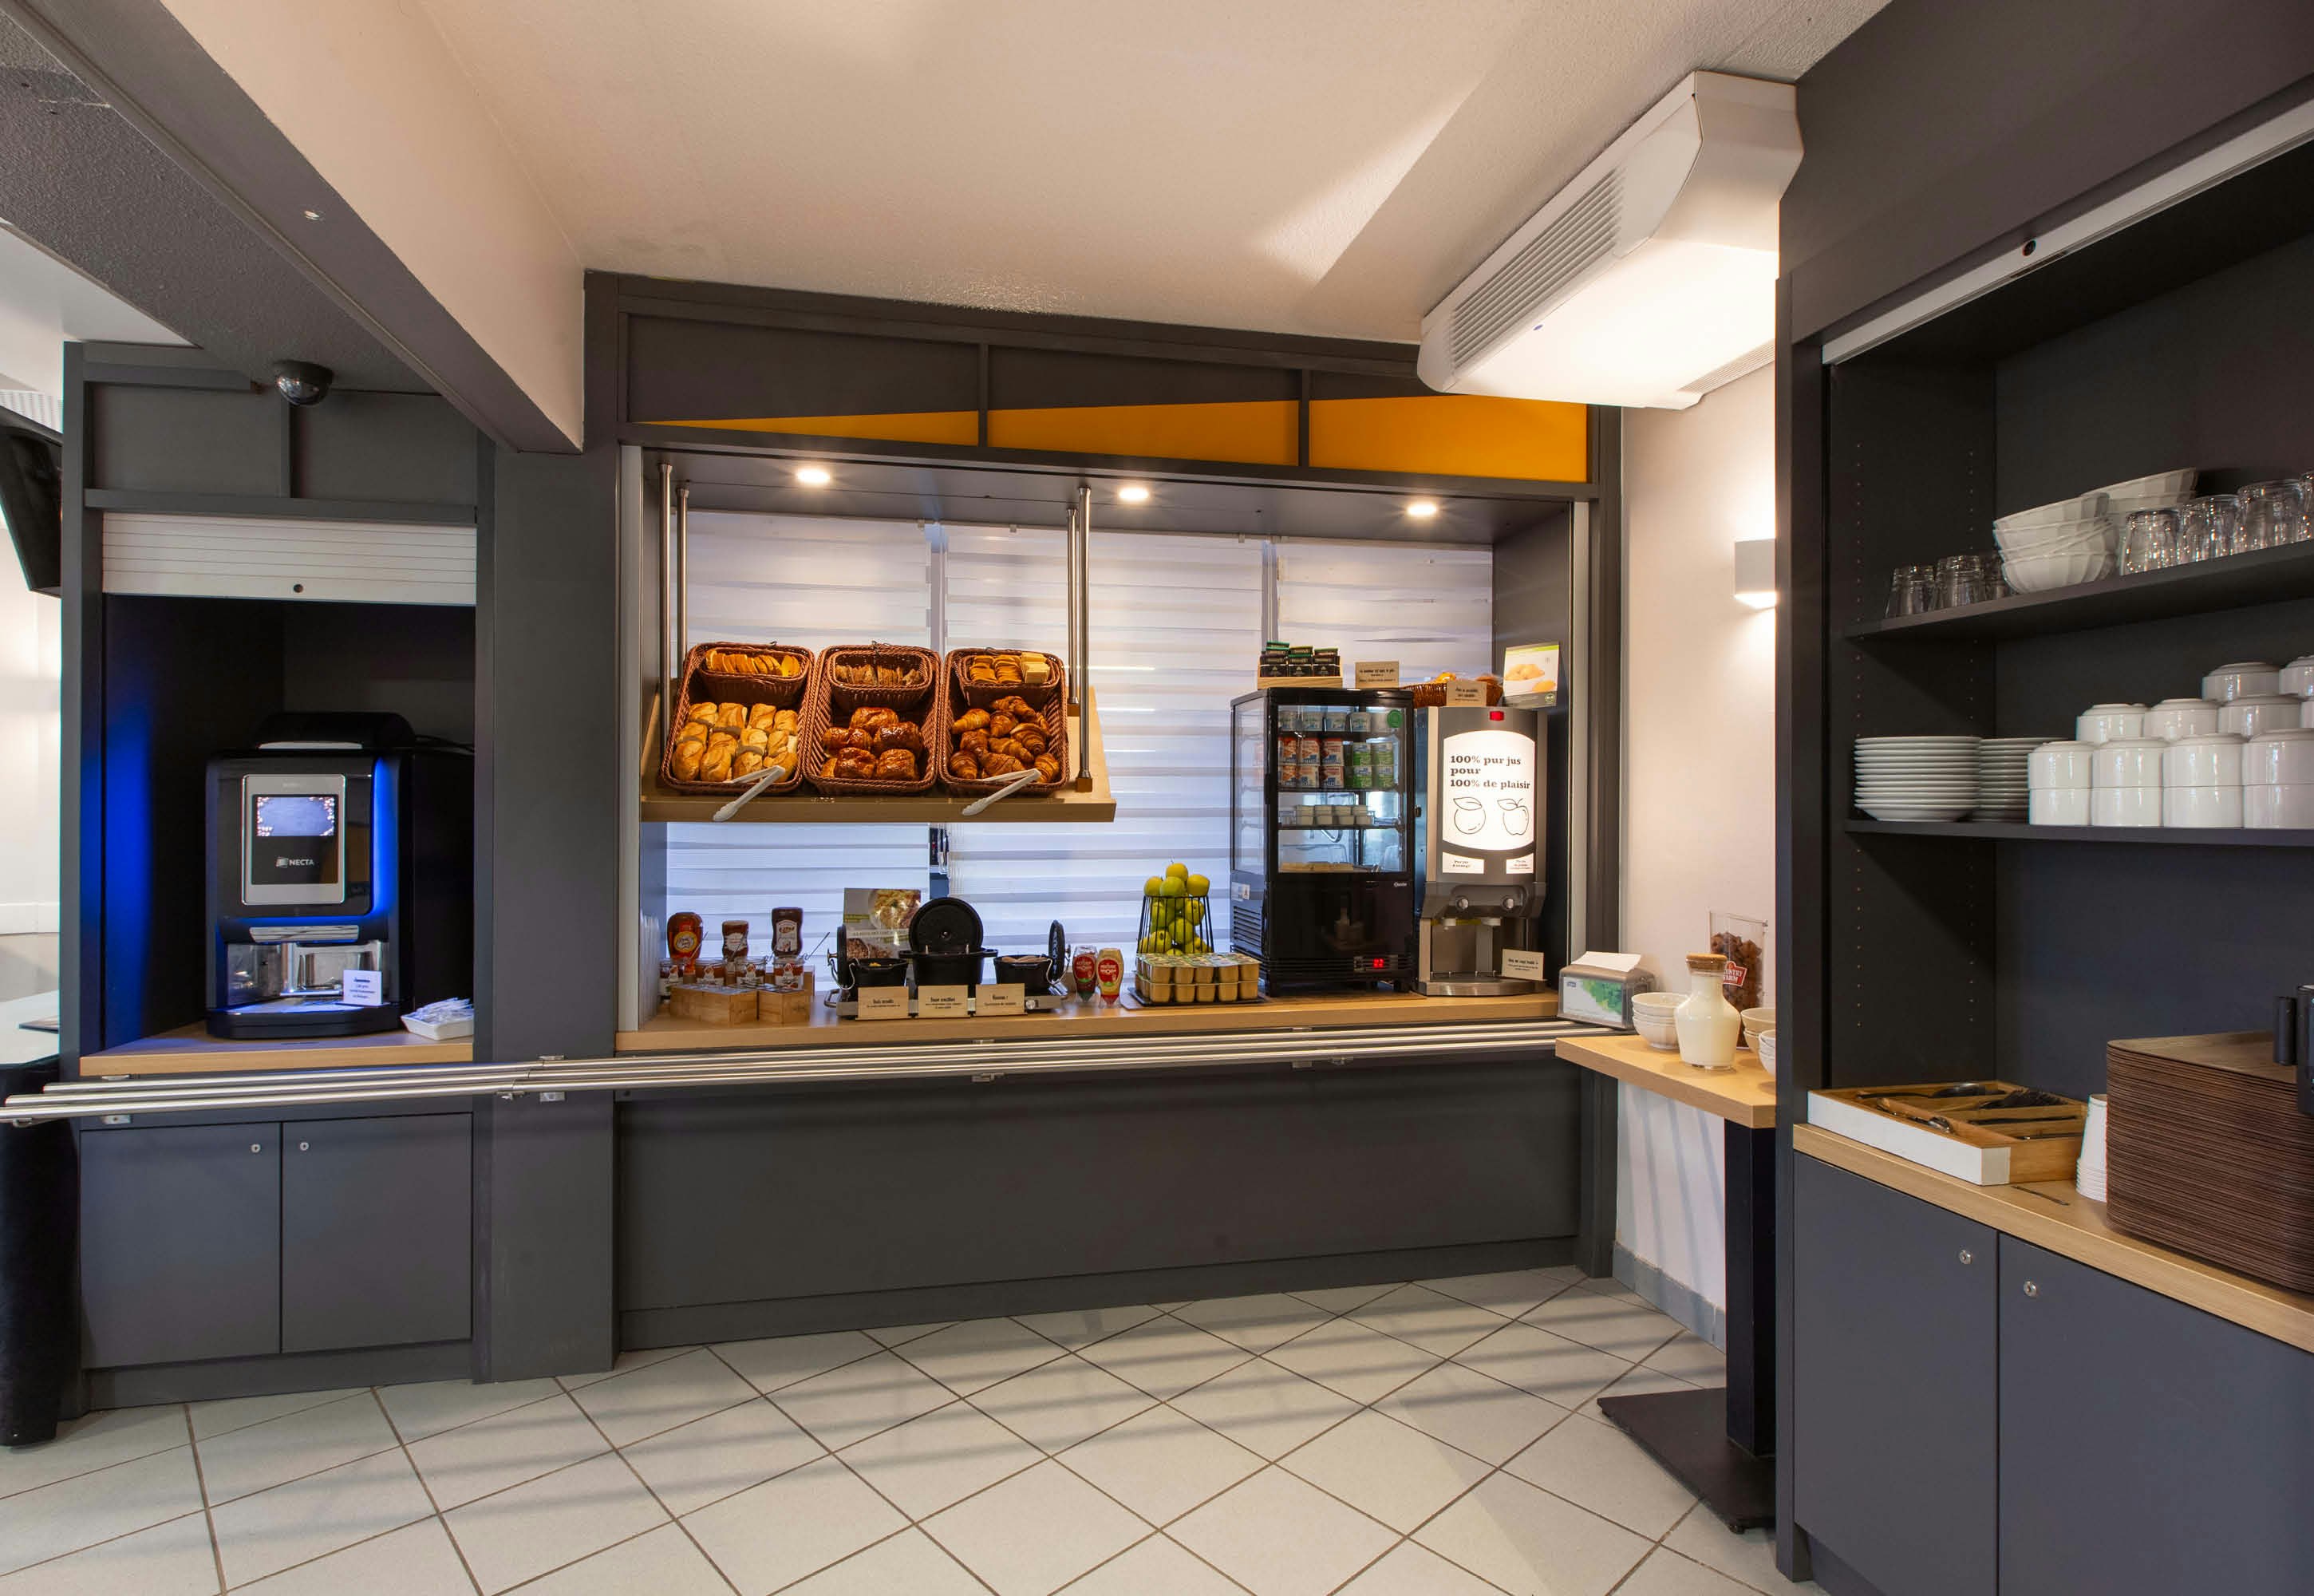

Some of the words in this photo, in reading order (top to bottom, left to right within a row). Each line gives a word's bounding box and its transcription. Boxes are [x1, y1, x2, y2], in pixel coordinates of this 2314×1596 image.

[1450, 755, 1481, 764] 100%
[1483, 757, 1504, 766] pur
[1506, 756, 1522, 767] jus
[1500, 780, 1530, 790] plaisir
